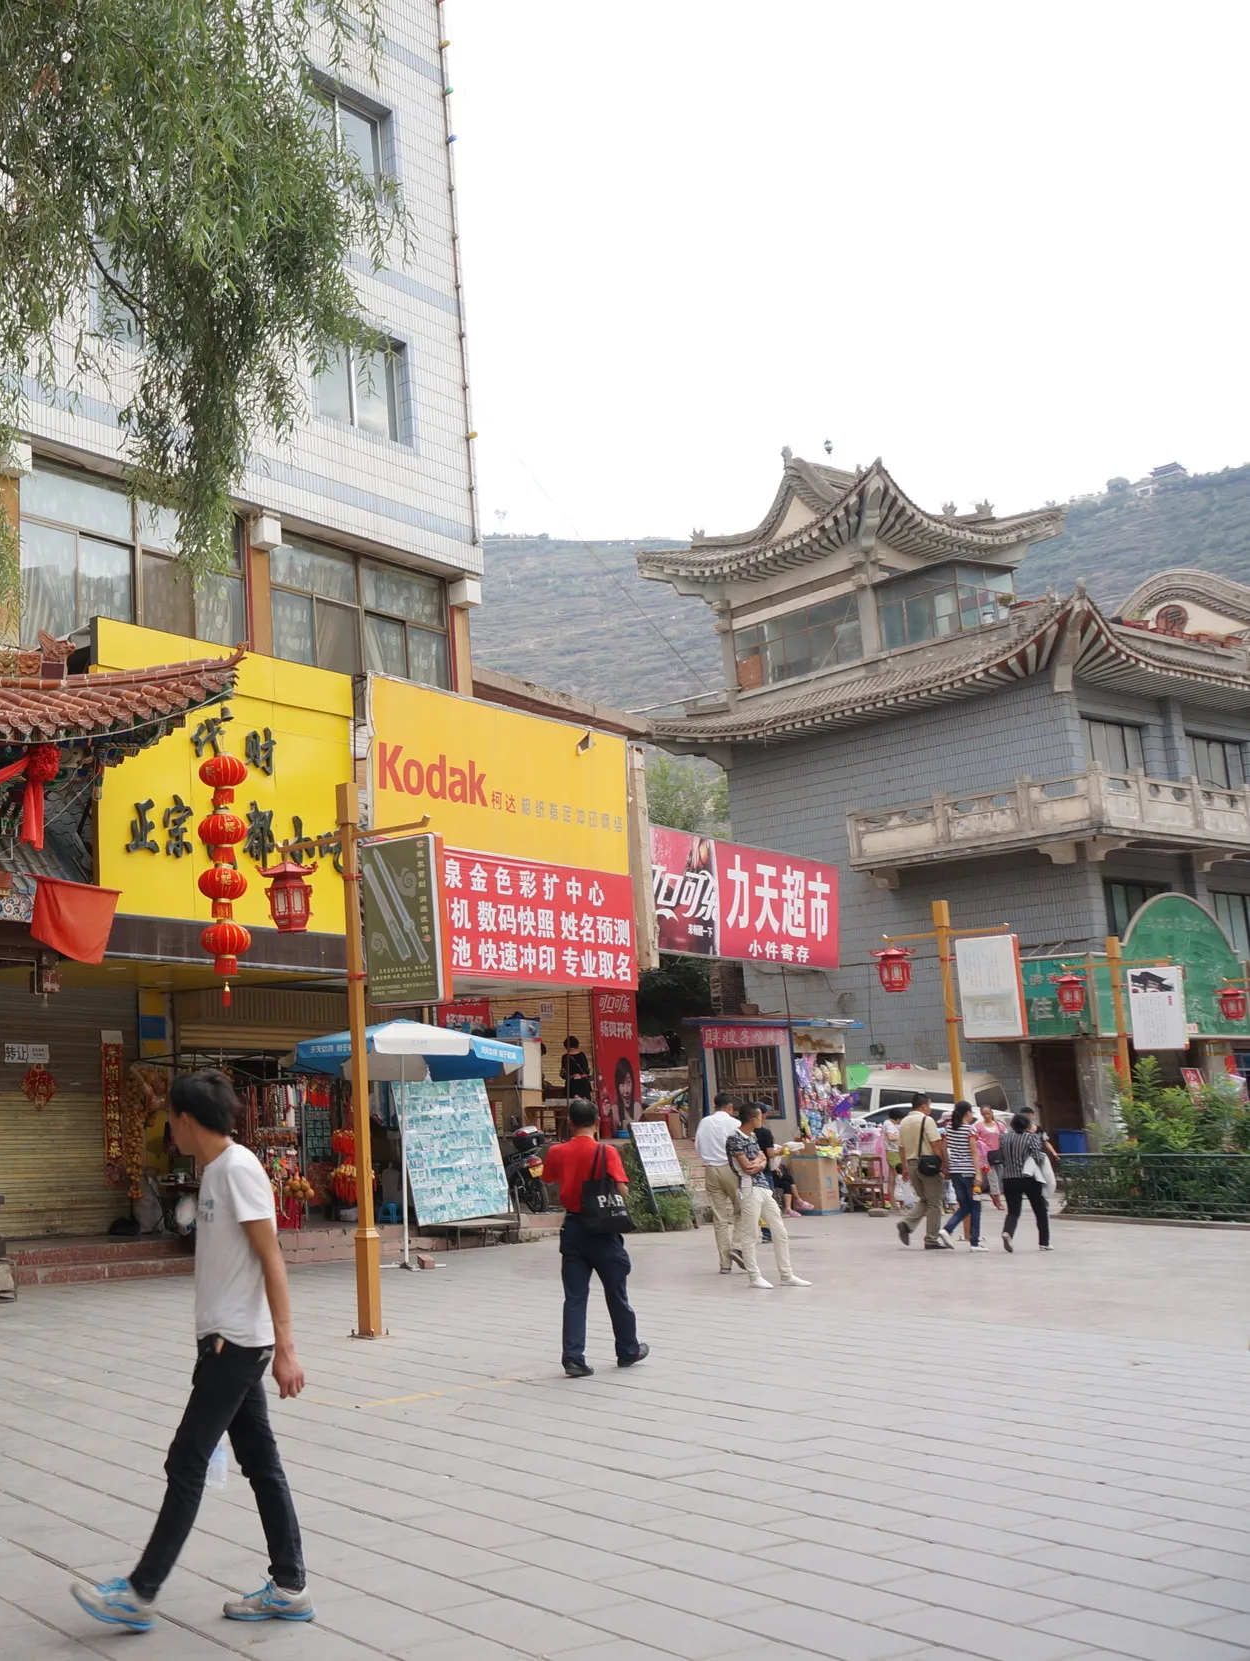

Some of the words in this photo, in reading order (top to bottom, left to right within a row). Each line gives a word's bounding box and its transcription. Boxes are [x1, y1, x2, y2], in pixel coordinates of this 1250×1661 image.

[378, 741, 488, 808] Kodak
[491, 790, 517, 814] 柯达
[125, 794, 345, 874] 正宗都小吃
[444, 858, 605, 907] 泉金色彩扩中心
[726, 854, 830, 941] 力天超市
[446, 896, 472, 930] 机
[477, 900, 555, 939] 数码快照
[560, 911, 630, 948] 姓名预测
[451, 935, 472, 968] 池
[478, 937, 556, 975] 快速冲印
[562, 946, 632, 982] 专业取名
[748, 939, 810, 963] 小件寄存
[598, 994, 631, 1014] 可口可乐
[5, 1046, 27, 1062] 转让
